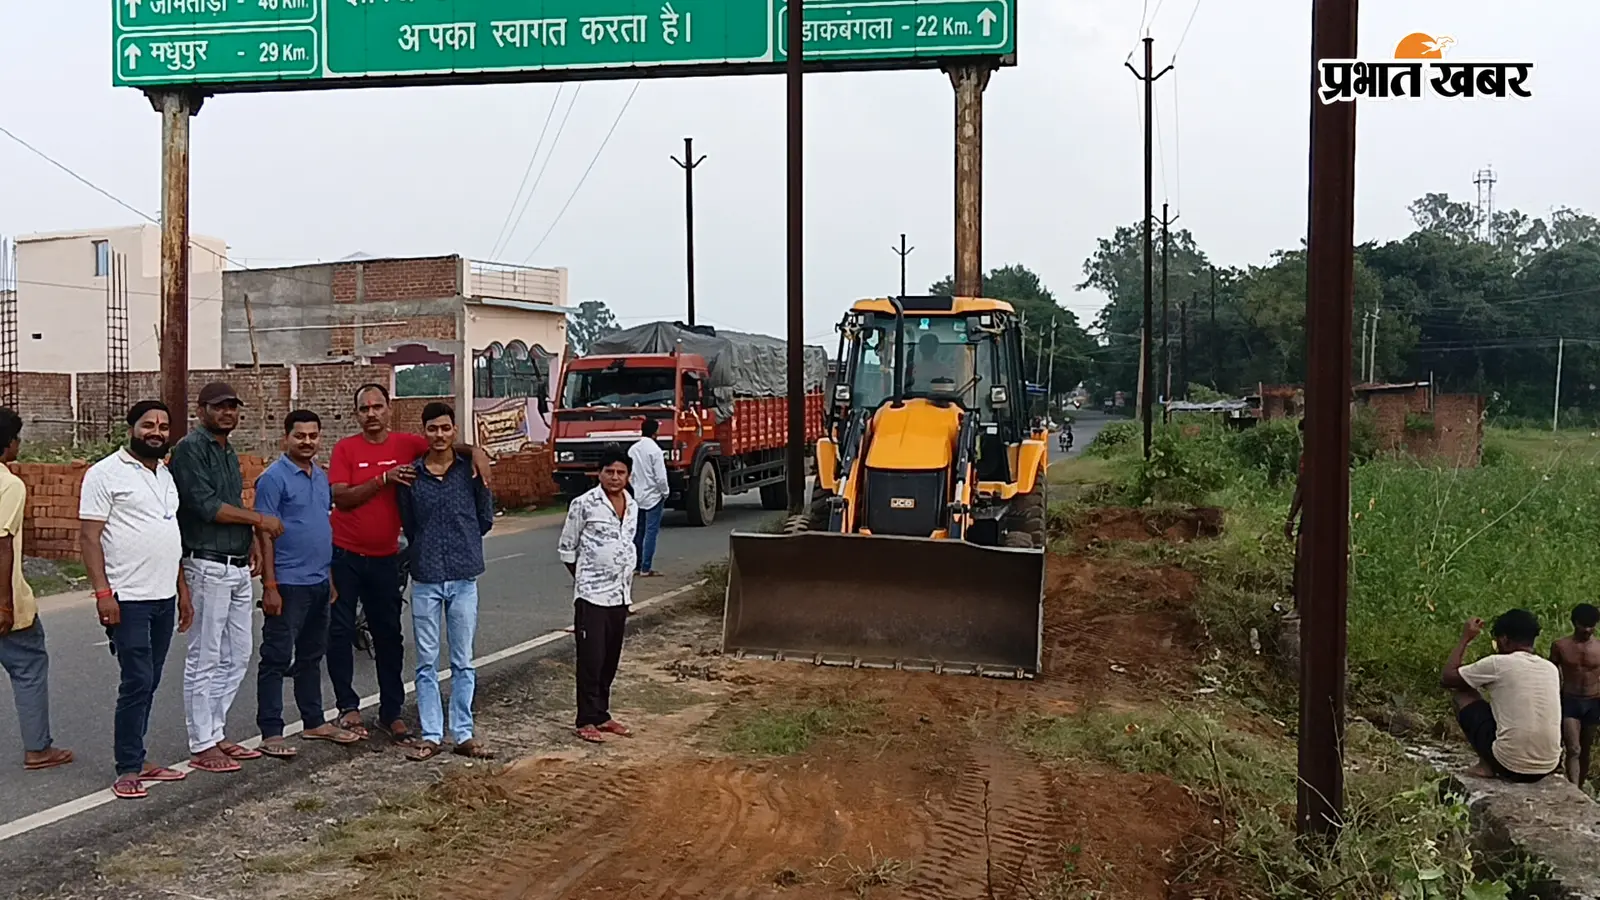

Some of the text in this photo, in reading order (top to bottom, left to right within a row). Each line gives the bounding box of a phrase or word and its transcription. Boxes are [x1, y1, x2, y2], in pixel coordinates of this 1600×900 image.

[398, 22, 476, 51] अपका
[490, 18, 567, 47] स्वागत
[579, 15, 647, 45] करता
[916, 15, 938, 37] 22
[943, 16, 973, 36] Km.
[148, 41, 209, 70] मधुपुर
[259, 42, 279, 62] 29
[282, 43, 310, 61] Km.
